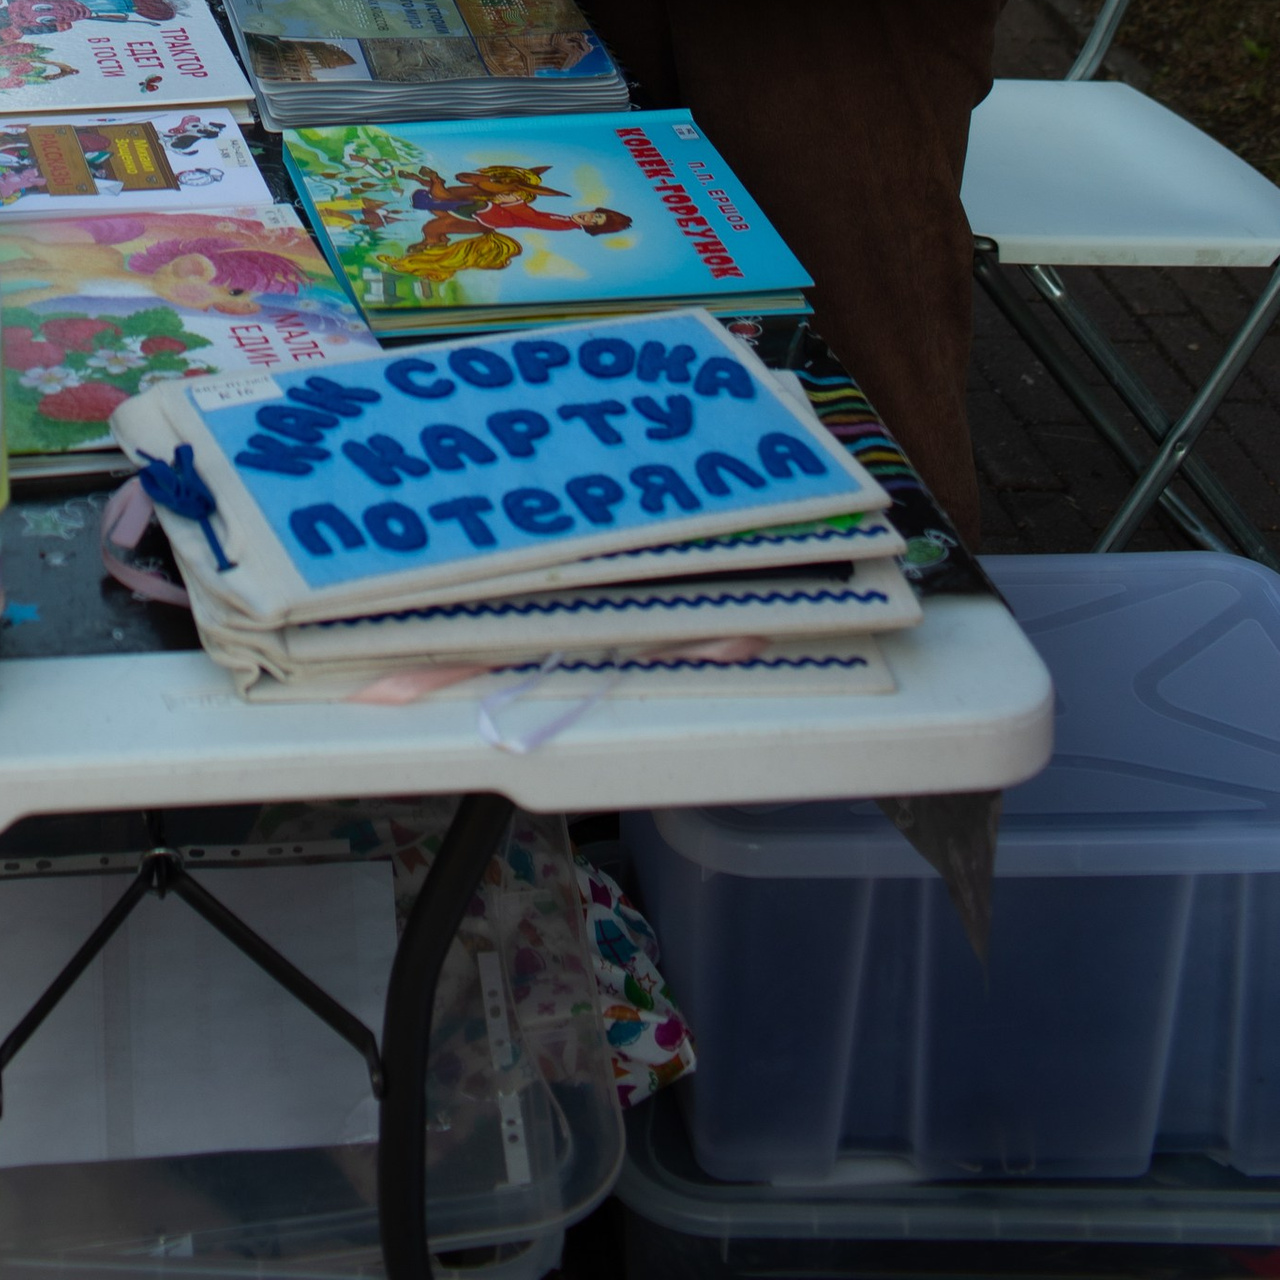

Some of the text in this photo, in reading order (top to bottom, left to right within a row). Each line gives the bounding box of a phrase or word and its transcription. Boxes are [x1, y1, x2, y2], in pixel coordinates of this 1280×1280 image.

[403, 8, 425, 30] мира
[423, 2, 451, 35] истории
[91, 46, 126, 78] ГОСТИ
[123, 41, 165, 69] ЕДЕТ
[159, 27, 209, 78] ТРАКТОР
[37, 133, 74, 187] РАССКАЗЫ
[114, 138, 139, 175] Зощенко
[132, 139, 156, 172] Михаил
[614, 126, 746, 280] КОНЁК-ГОРБУНОК
[687, 161, 750, 232] П.П. ЕРШОВ
[232, 336, 758, 477] КАК СОРОКА
[340, 392, 694, 487] КАРТУ
[288, 431, 827, 557] ПОТЕРЯЛА
